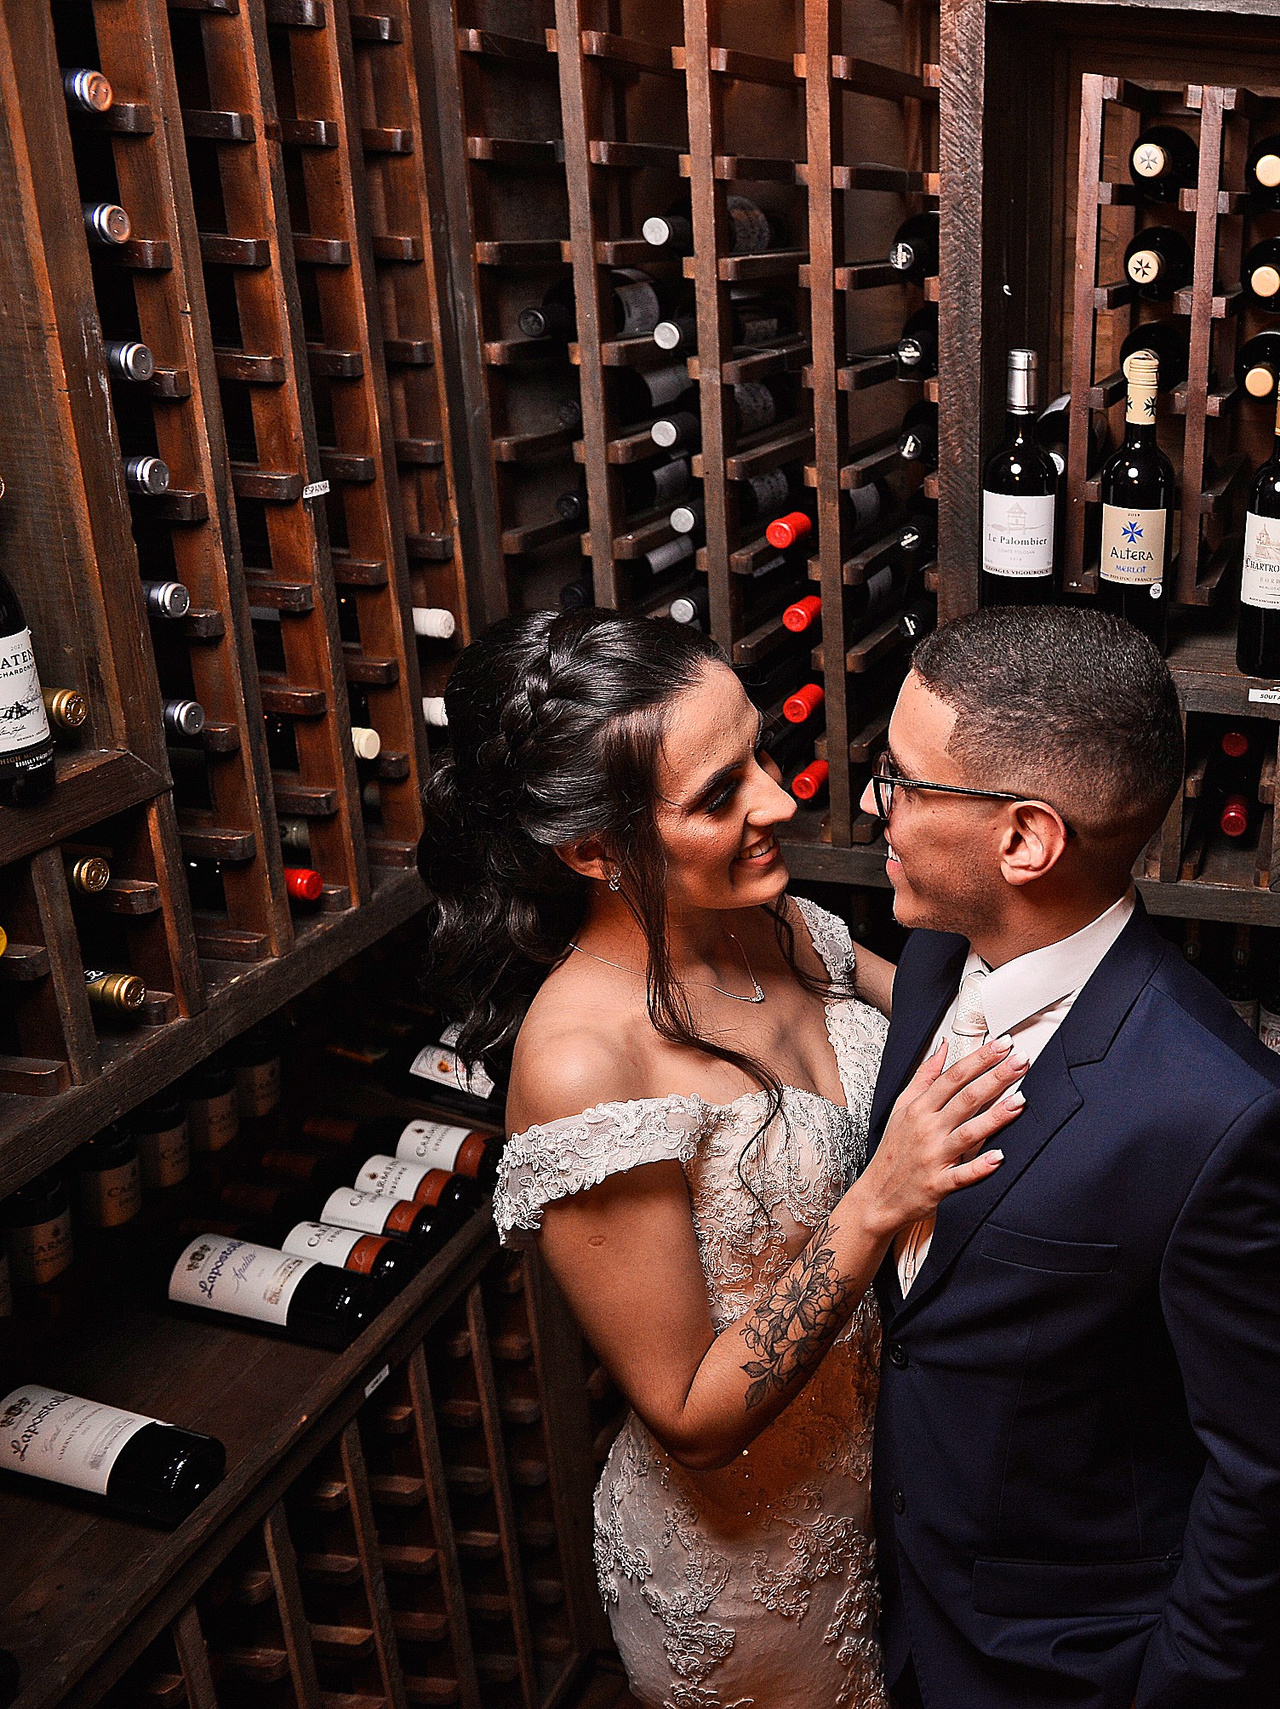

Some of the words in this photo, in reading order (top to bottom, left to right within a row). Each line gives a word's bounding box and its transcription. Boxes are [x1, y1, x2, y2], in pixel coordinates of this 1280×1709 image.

[988, 532, 997, 544] Le
[1000, 535, 1048, 546] Palombier
[1110, 546, 1154, 561] ALTERA
[1115, 564, 1147, 574] MERLOT
